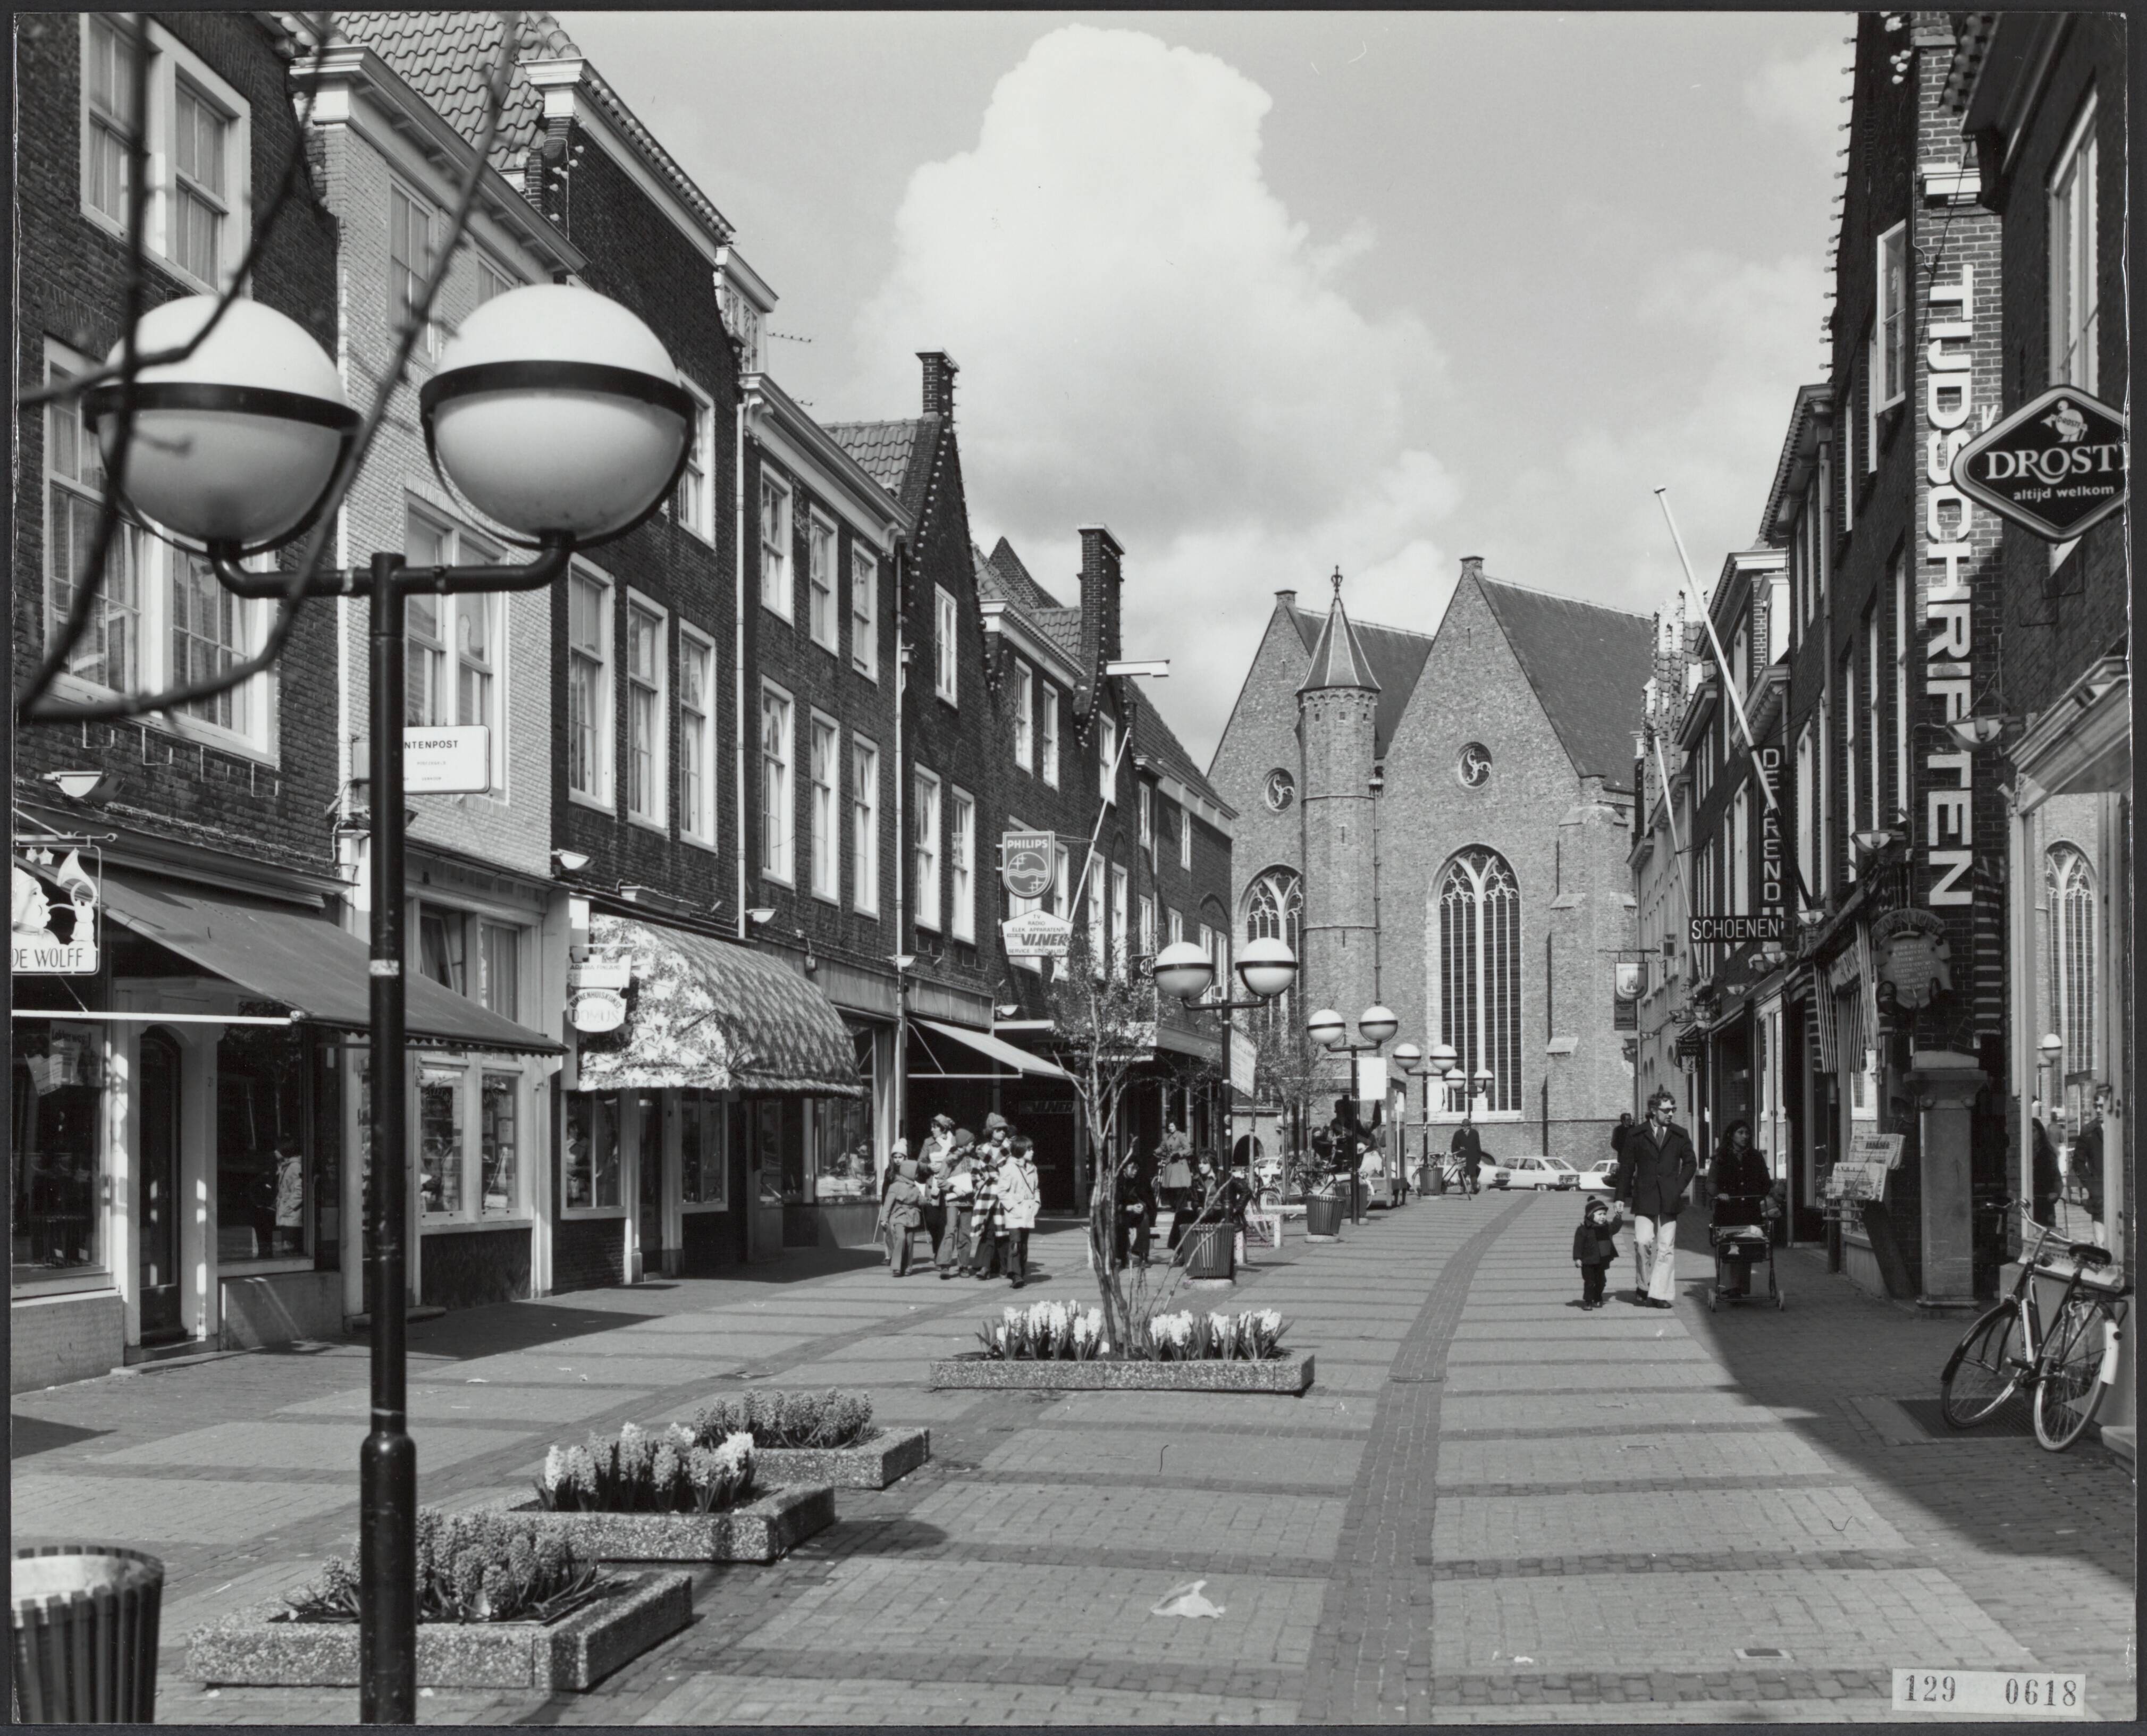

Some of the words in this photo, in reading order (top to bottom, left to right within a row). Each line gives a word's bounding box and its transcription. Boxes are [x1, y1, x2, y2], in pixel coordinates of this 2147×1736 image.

[2014, 487, 2051, 502] altijd
[2057, 484, 2115, 498] welkom
[1927, 264, 1973, 905] TIJDSCHRIFTEN
[404, 740, 459, 749] NTENPOST
[1007, 839, 1048, 849] PHILIPS
[1691, 918, 1778, 940] SCHOENEN
[12, 948, 28, 968] DE
[35, 948, 83, 967] WOLFF
[569, 991, 622, 1008] BINNENHUISKUNST
[571, 1009, 620, 1023] DOMUS
